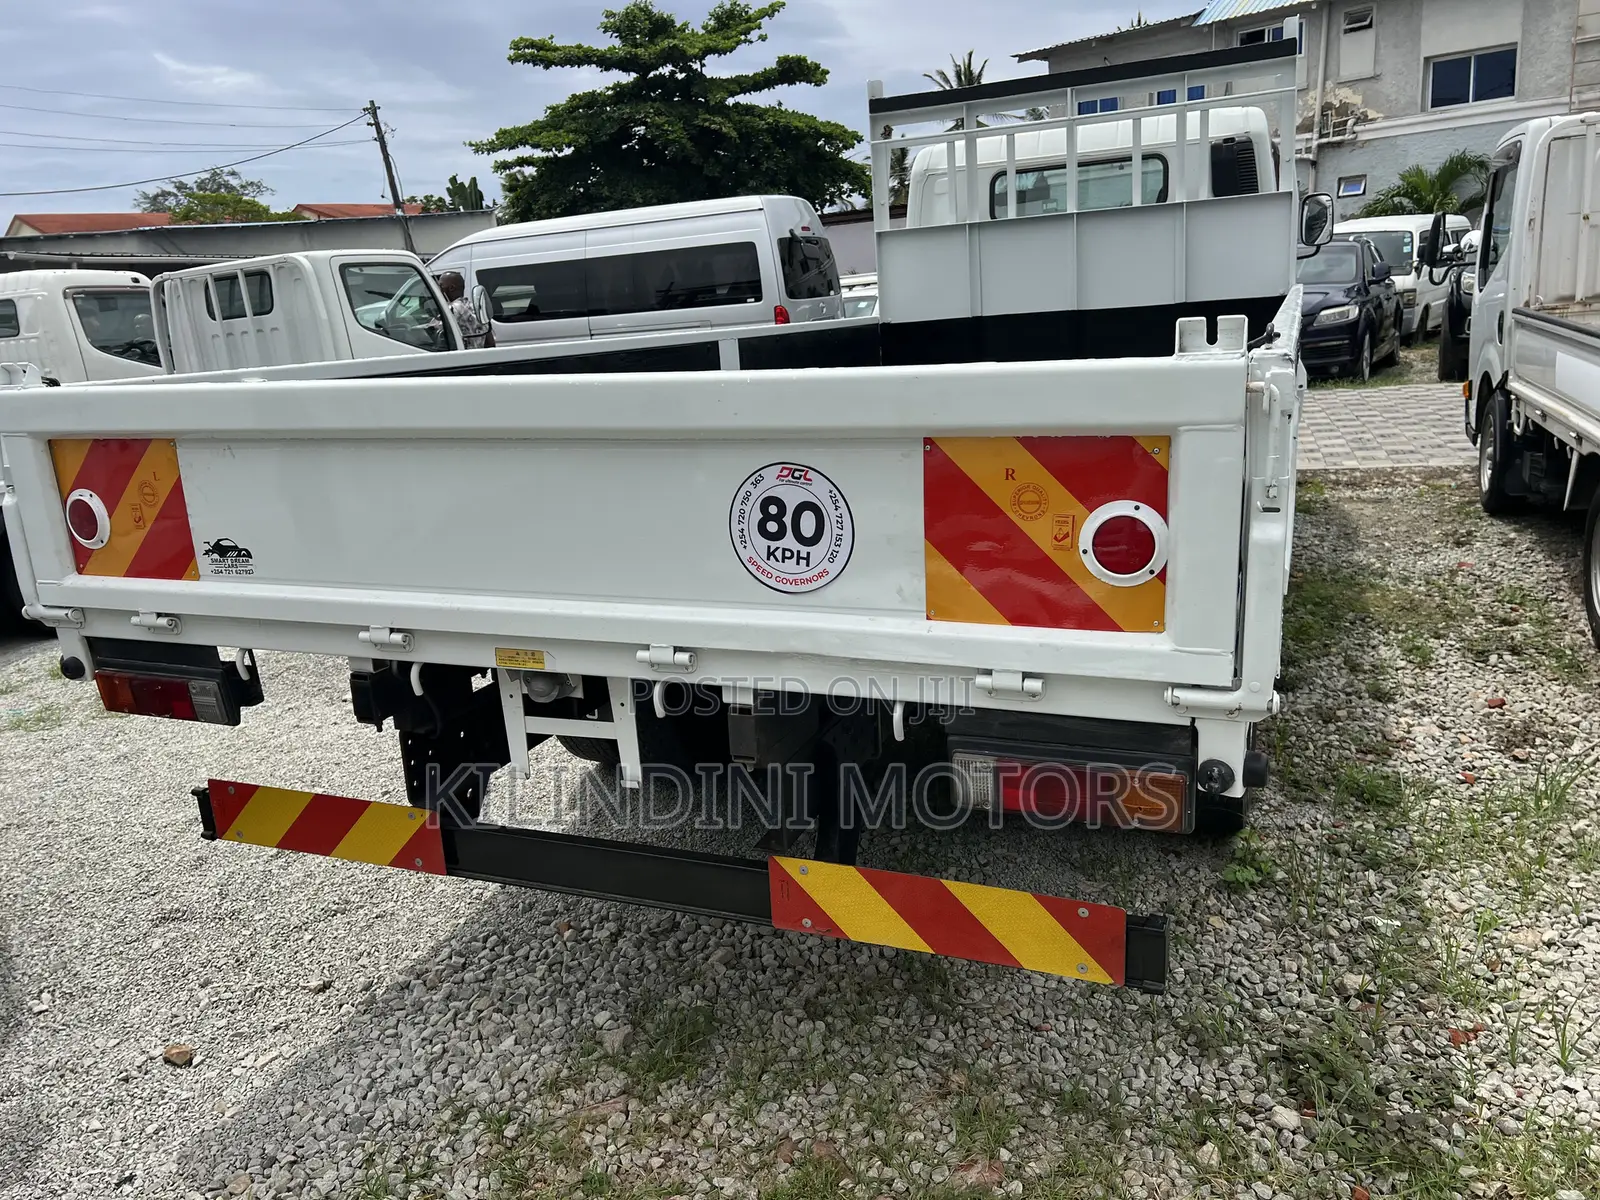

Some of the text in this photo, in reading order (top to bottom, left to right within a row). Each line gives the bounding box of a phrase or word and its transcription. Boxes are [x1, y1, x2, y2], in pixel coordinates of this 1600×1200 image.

[1004, 467, 1016, 481] R
[1012, 484, 1047, 507] SUPERIOR QUALITY
[738, 473, 765, 550] +254 720 750 363
[757, 495, 825, 547] 80
[827, 489, 844, 564] +254 727 153 120
[746, 556, 830, 586] SPEED GOVERNORS
[766, 545, 811, 567] KPH
